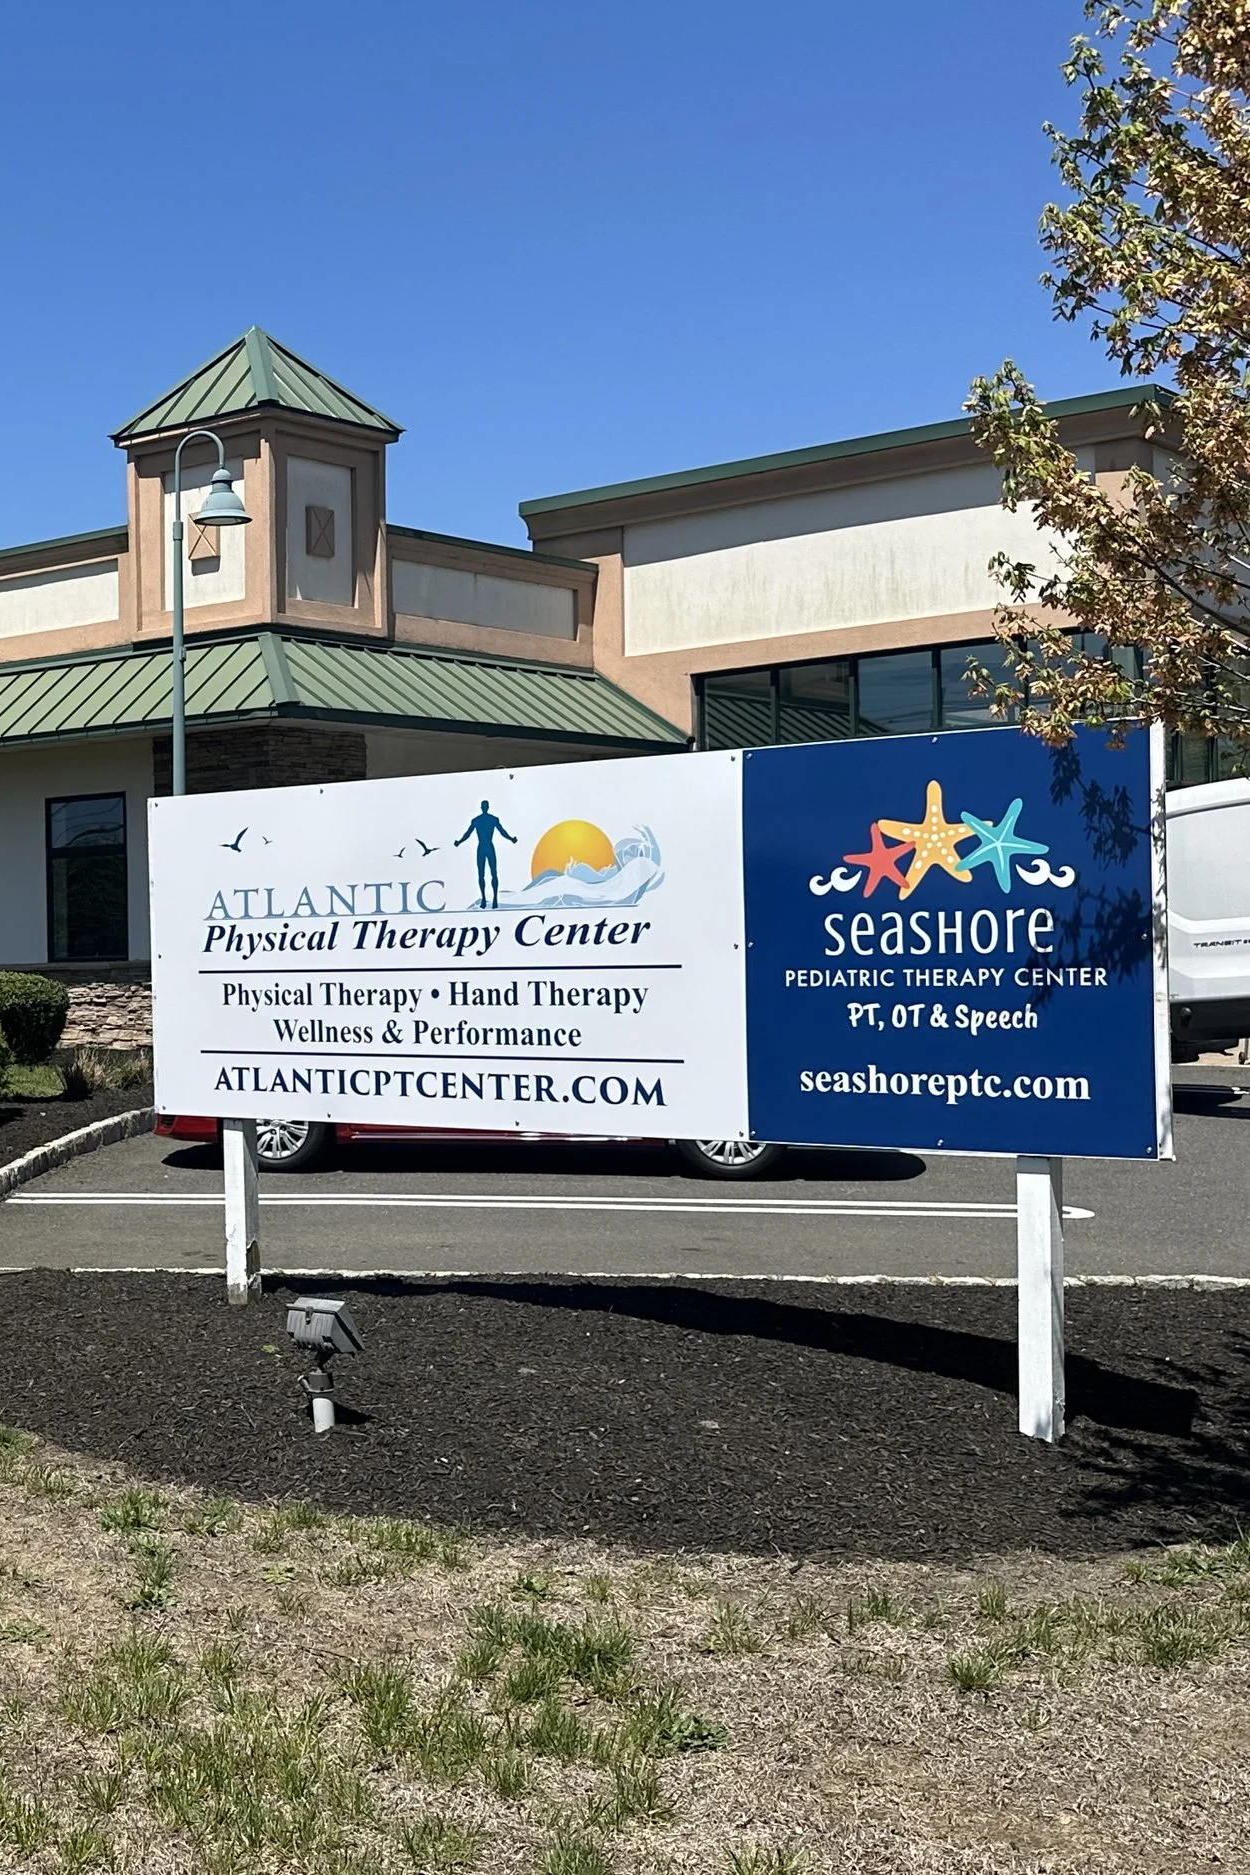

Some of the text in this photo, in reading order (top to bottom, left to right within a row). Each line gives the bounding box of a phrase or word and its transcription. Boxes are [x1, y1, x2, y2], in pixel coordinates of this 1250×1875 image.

[208, 879, 447, 921] ATLANTIC
[202, 914, 651, 960] Physical Therapy Center
[784, 967, 1108, 988] PEDIATRIC THERAPY CENTER
[221, 980, 650, 1015] Physical Therapy Hand Therapy
[272, 1018, 582, 1048] Wellness & Performance
[846, 1002, 1039, 1036] PT, OT & Speech
[213, 1065, 668, 1107] ATLANTICPTCENTER.COM
[799, 1064, 1091, 1105] seashoreptc.com
